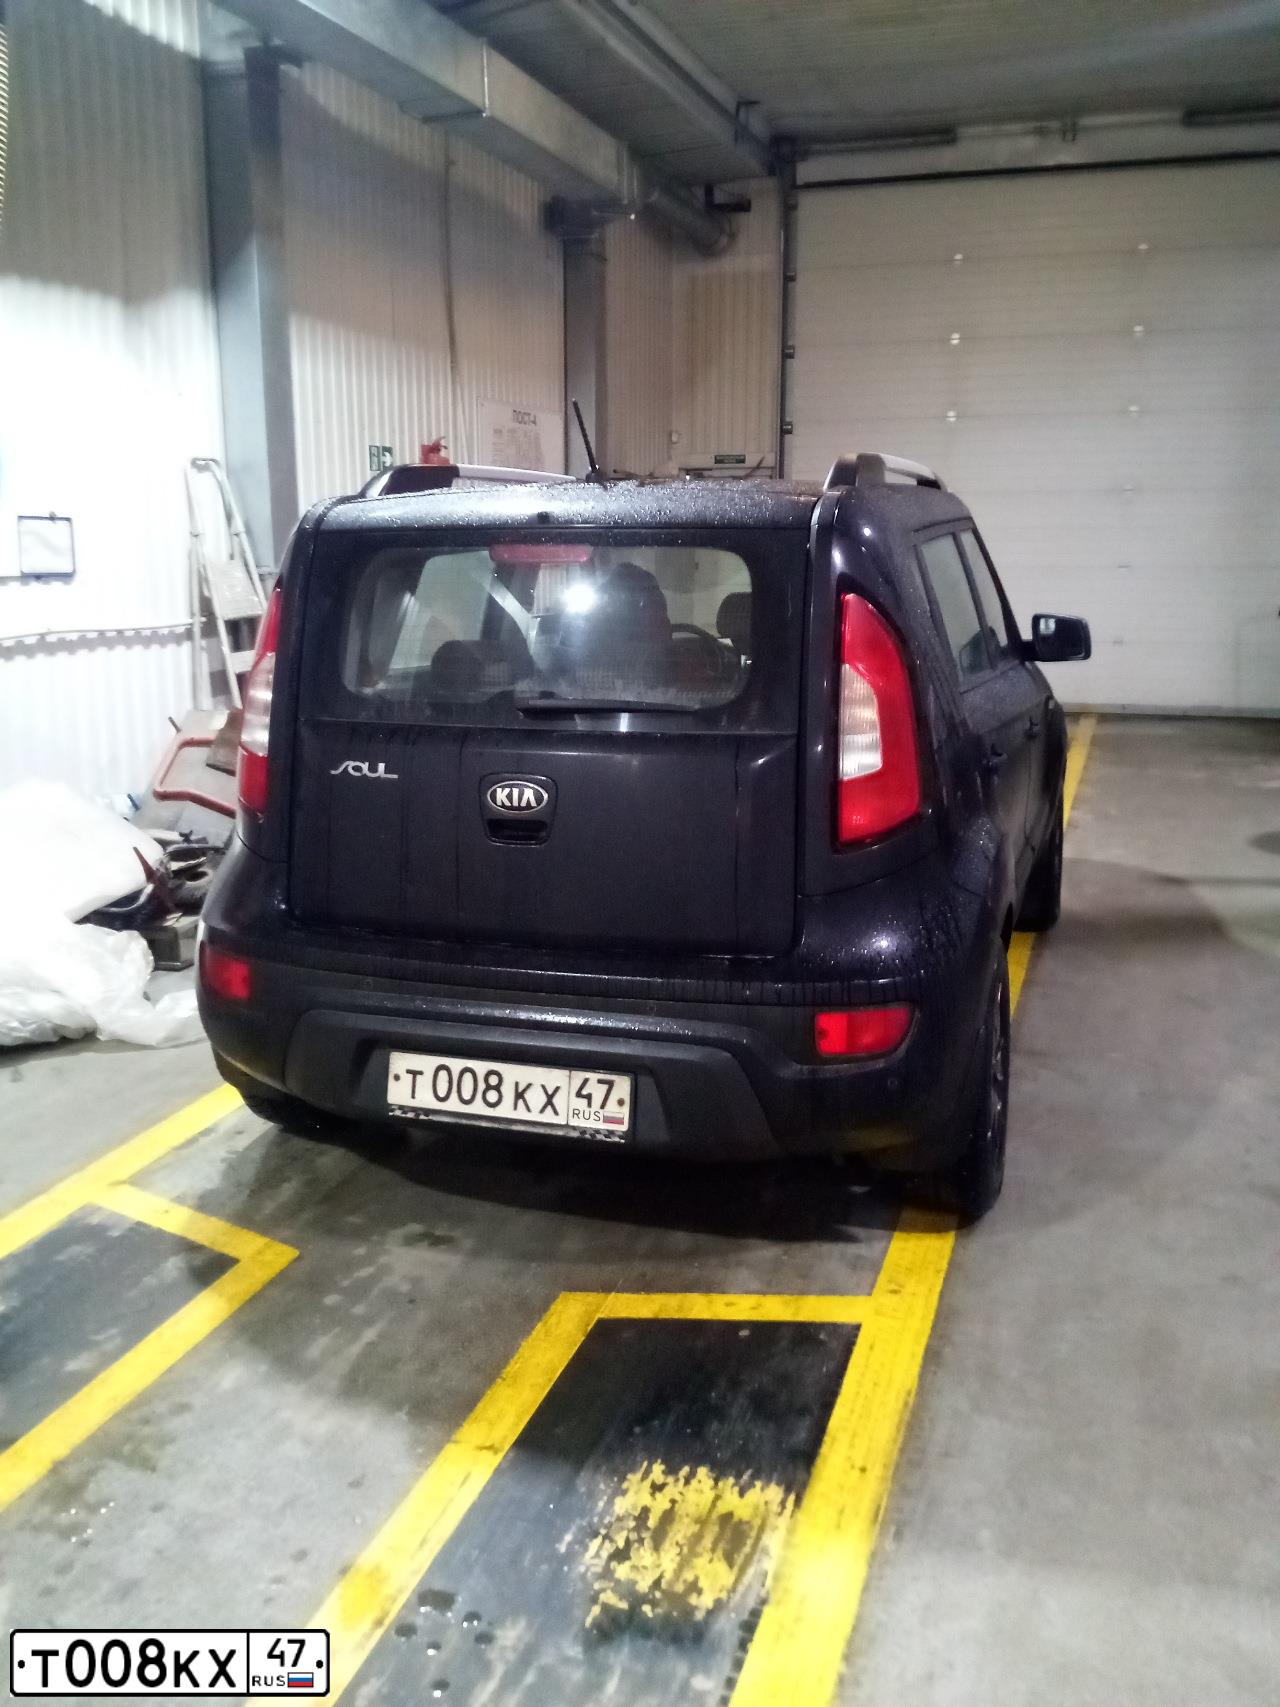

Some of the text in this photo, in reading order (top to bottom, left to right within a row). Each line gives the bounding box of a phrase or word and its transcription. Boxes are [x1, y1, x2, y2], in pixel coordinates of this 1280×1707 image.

[330, 760, 398, 779] SOUL
[495, 787, 537, 807] KIA
[575, 1077, 615, 1110] 47
[572, 1108, 601, 1122] RUS
